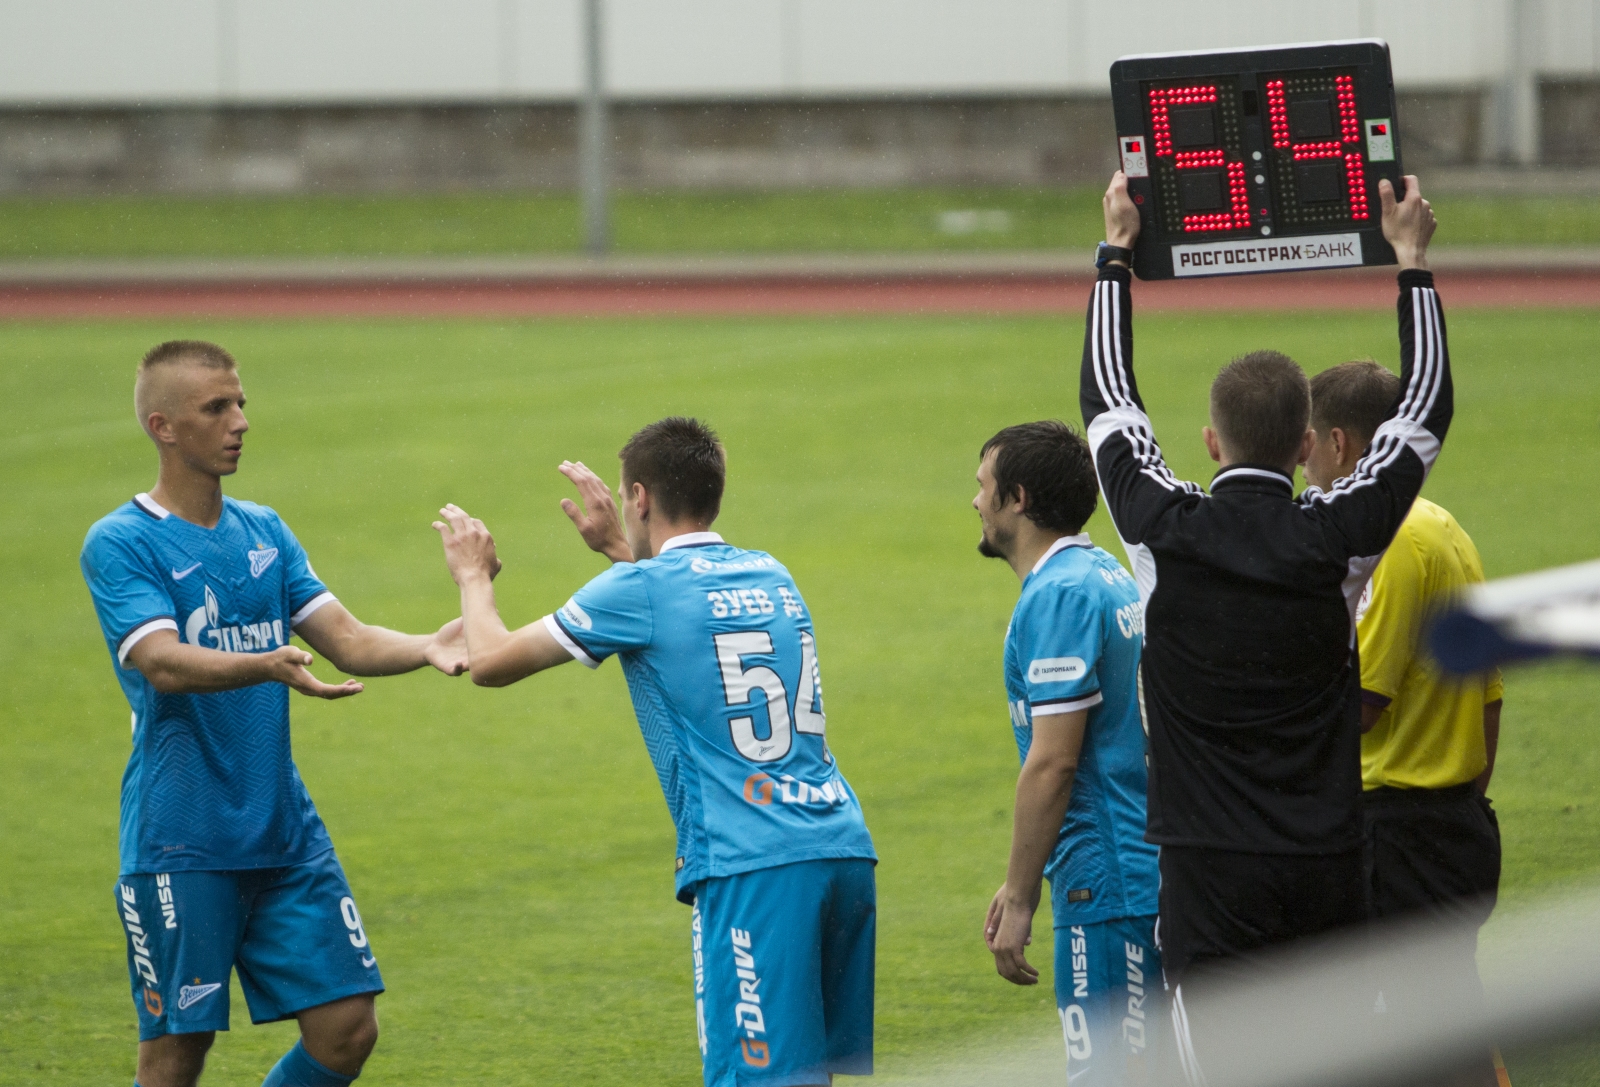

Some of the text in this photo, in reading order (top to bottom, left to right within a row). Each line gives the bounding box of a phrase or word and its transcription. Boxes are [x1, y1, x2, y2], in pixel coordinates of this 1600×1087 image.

[1149, 75, 1369, 232] 54
[1180, 245, 1303, 267] РОСГОССТРАХ
[707, 588, 775, 618] ЗУЕВ
[713, 630, 832, 764] 54
